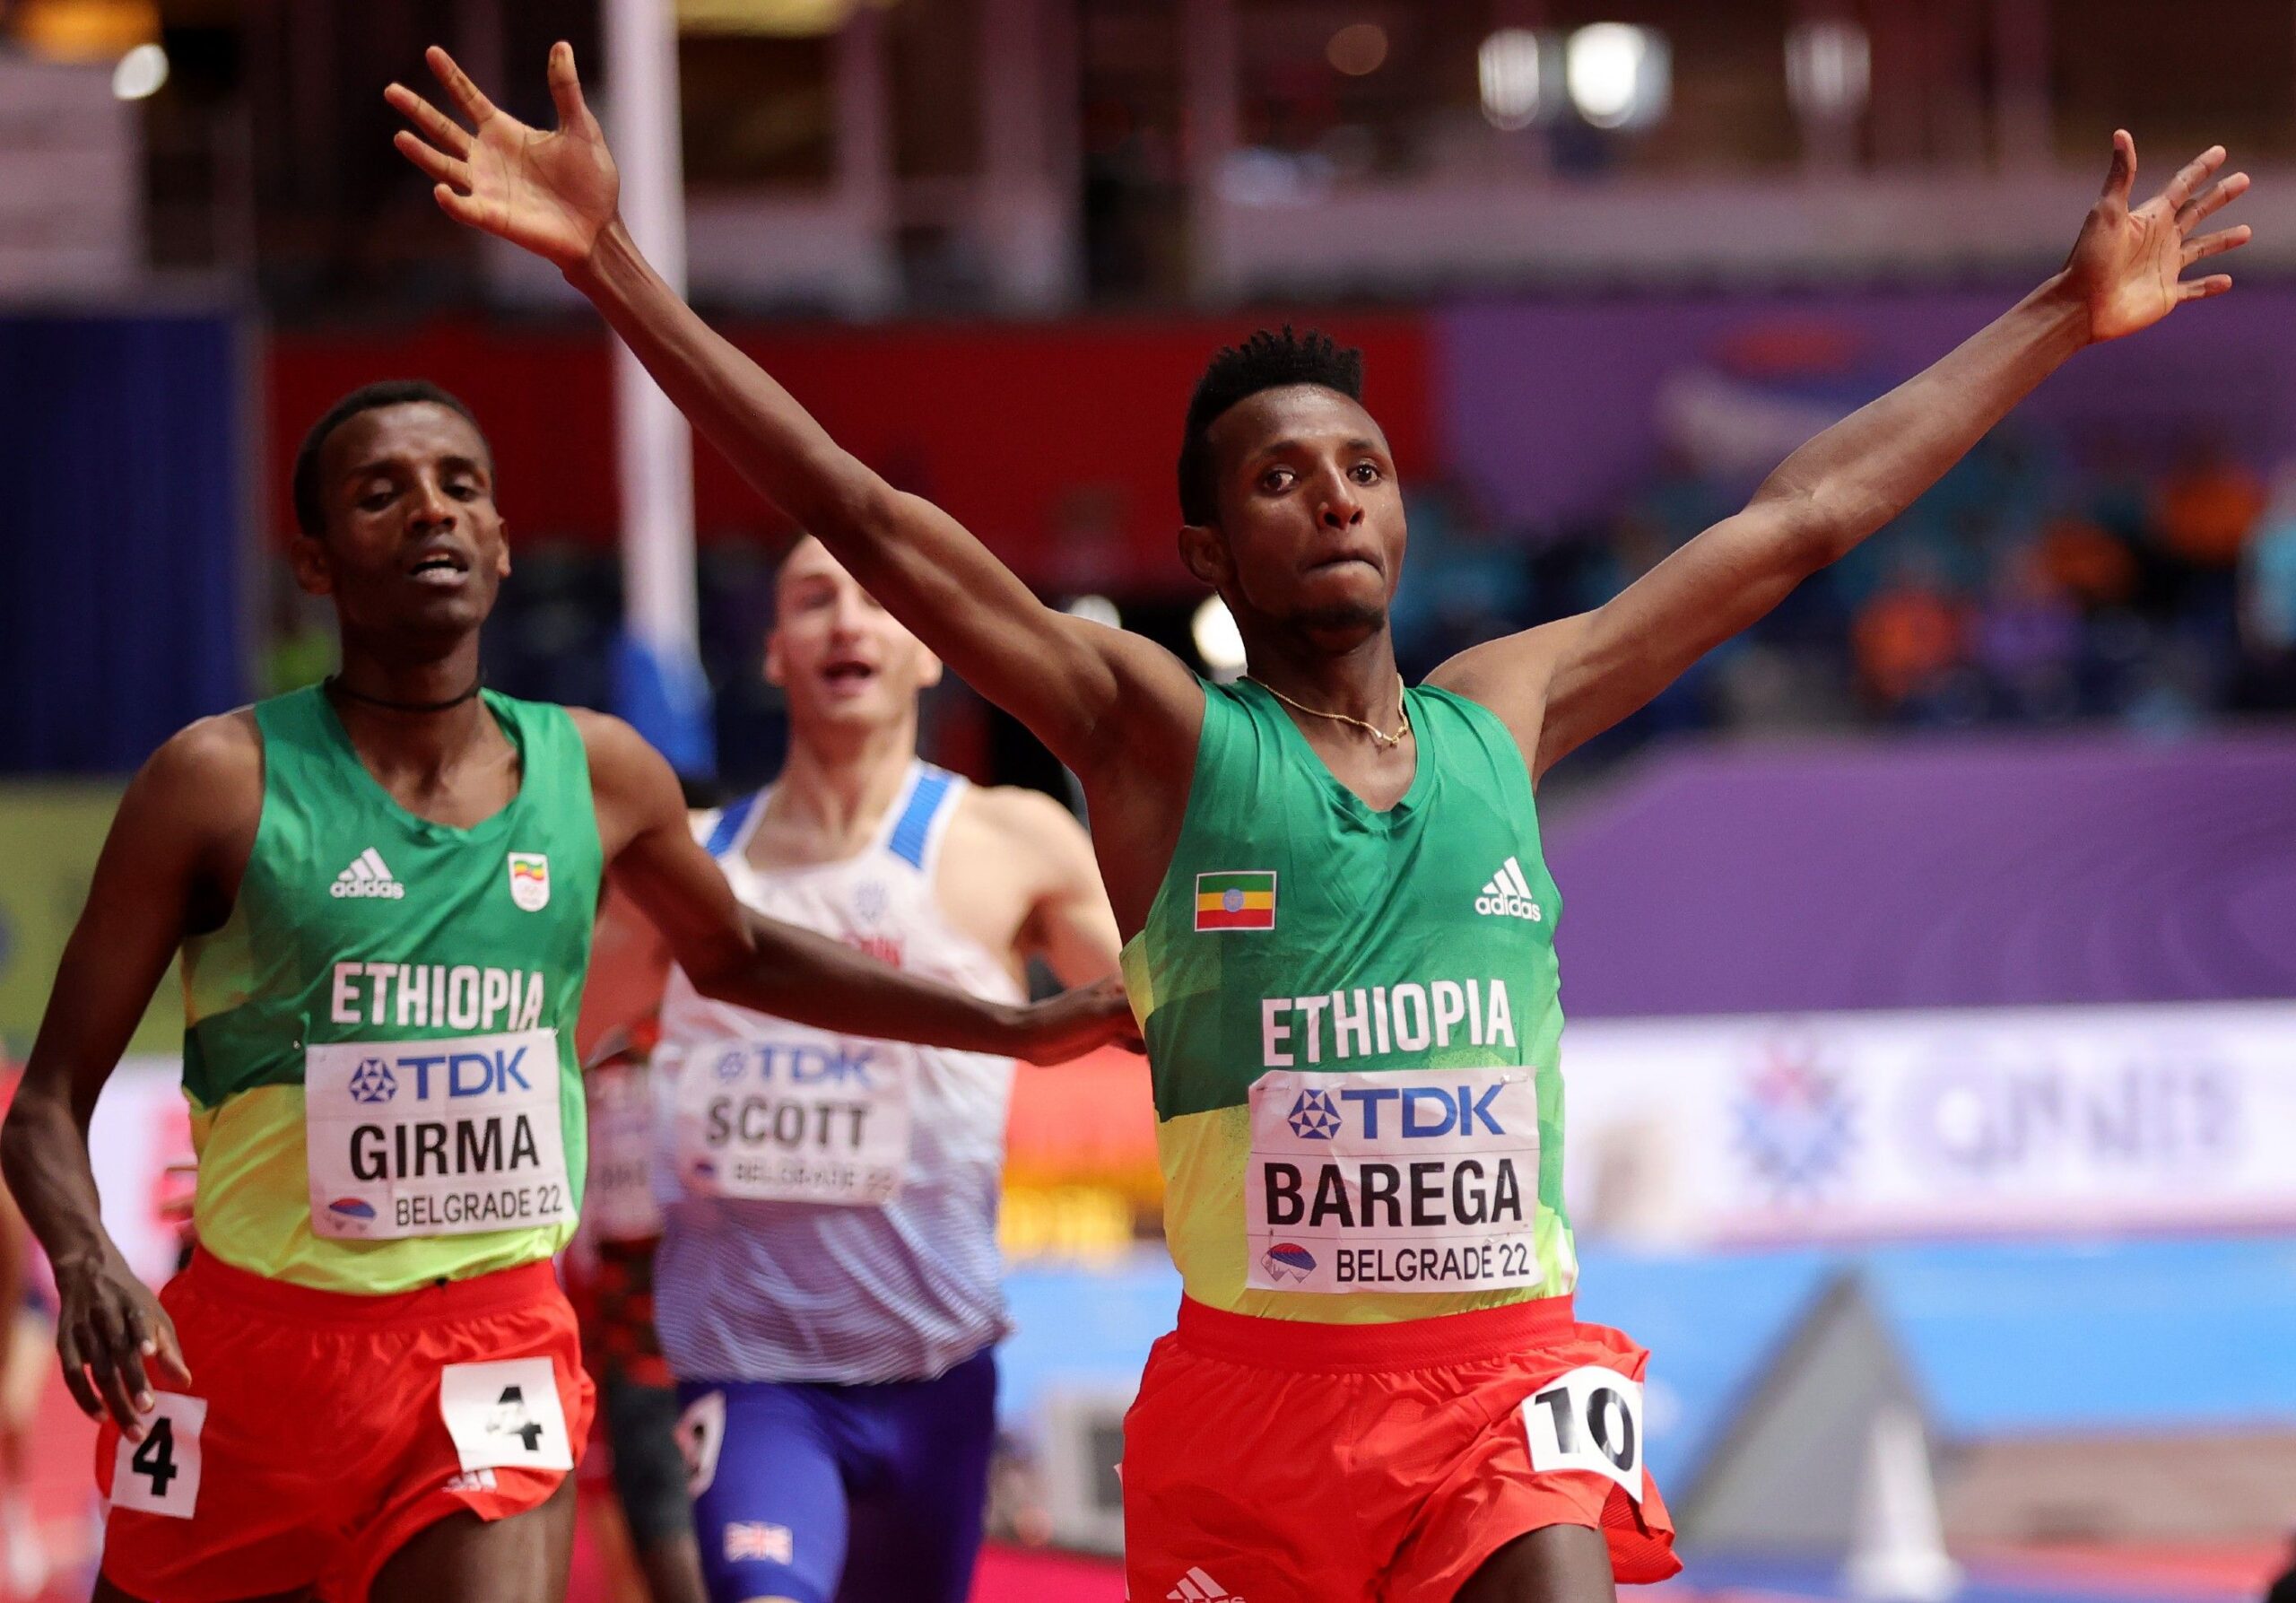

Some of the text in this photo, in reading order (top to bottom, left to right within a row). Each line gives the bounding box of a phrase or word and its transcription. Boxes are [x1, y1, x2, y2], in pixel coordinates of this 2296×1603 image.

[330, 879, 404, 899] adidas
[1474, 893, 1541, 922] adidas
[331, 962, 544, 1032] ETHIOPIA
[1262, 978, 1518, 1067] ETHIOPIA
[397, 1046, 531, 1101] TDK
[752, 1043, 875, 1088] TDK
[707, 1094, 870, 1150] SCOTT
[1341, 1084, 1507, 1140] TDK
[350, 1114, 539, 1181] GIRMA
[396, 1185, 562, 1226] BELGRADE 22
[1264, 1158, 1523, 1228] BAREGA
[1336, 1242, 1530, 1283] BELGRADE 22
[132, 1416, 178, 1496] 4
[1535, 1387, 1634, 1472] 10
